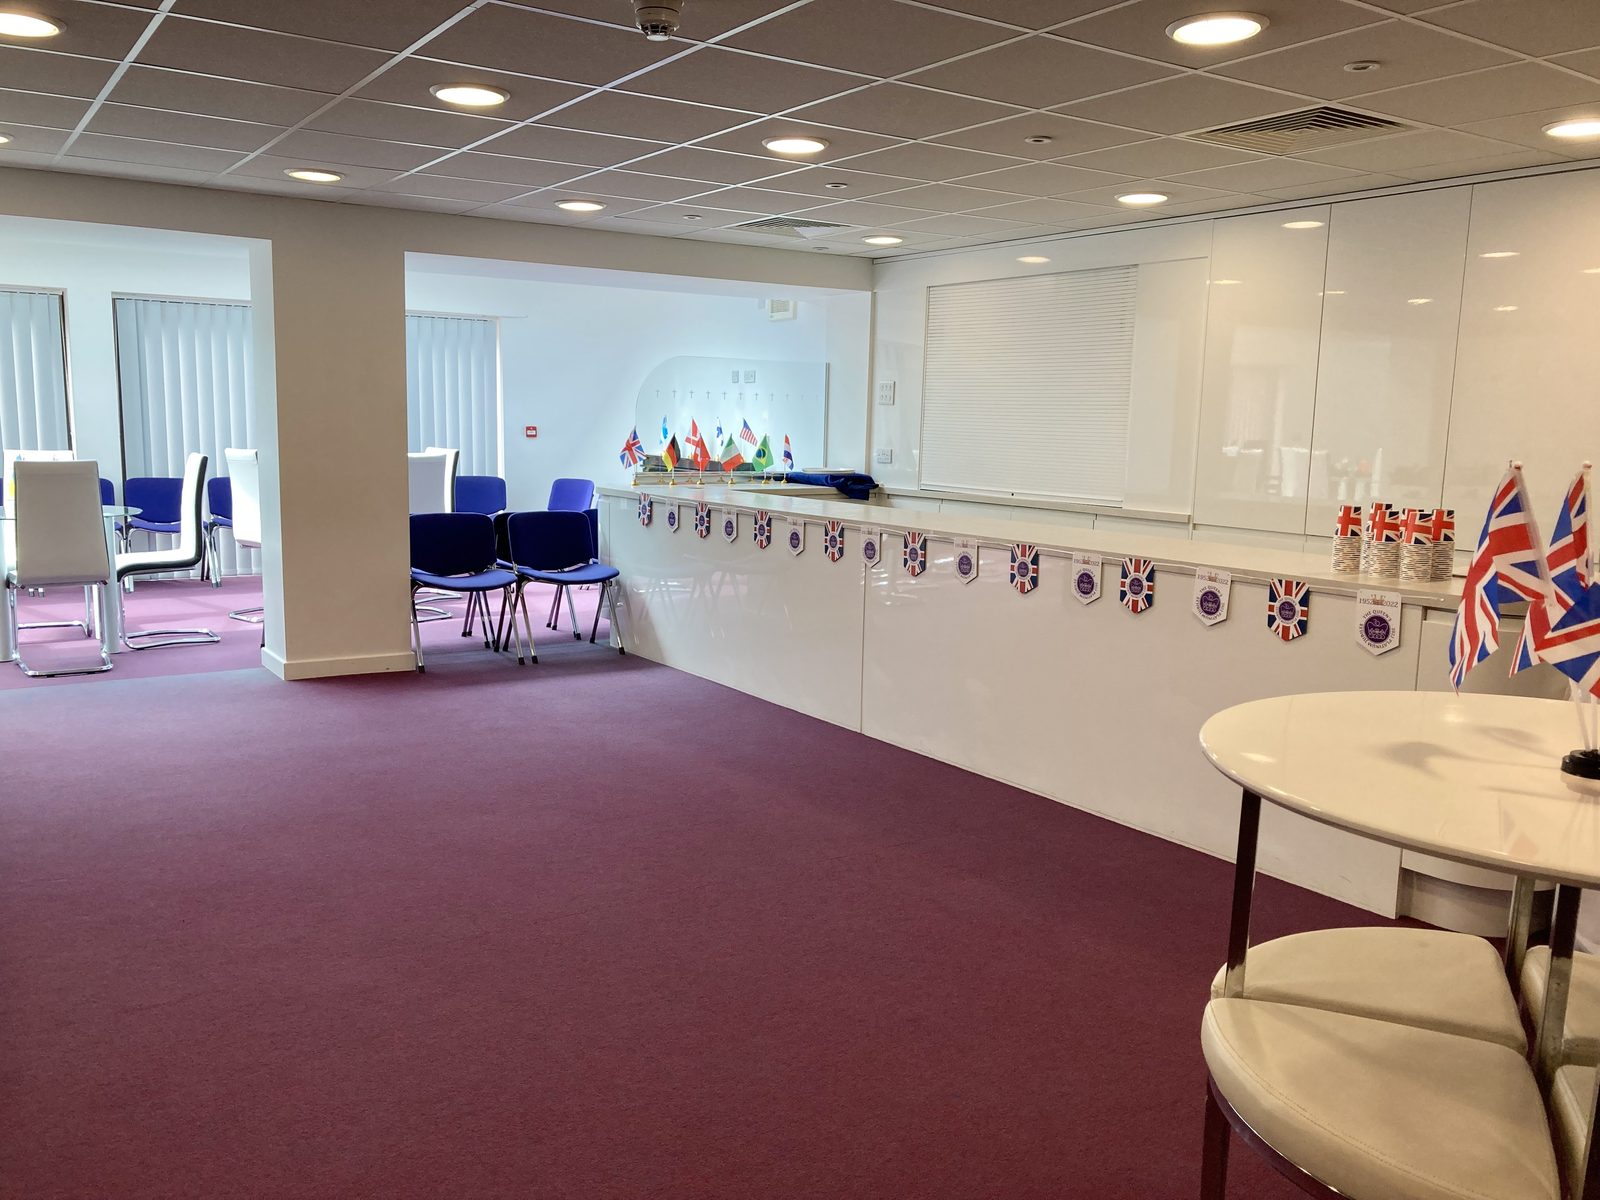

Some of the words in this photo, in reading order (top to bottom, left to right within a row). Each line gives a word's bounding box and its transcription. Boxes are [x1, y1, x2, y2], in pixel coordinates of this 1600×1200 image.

[1363, 611, 1372, 619] THE
[1372, 610, 1392, 622] QUEEN'S
[1359, 624, 1368, 643] JUBILEE
[1368, 639, 1392, 648] PLATINUM
